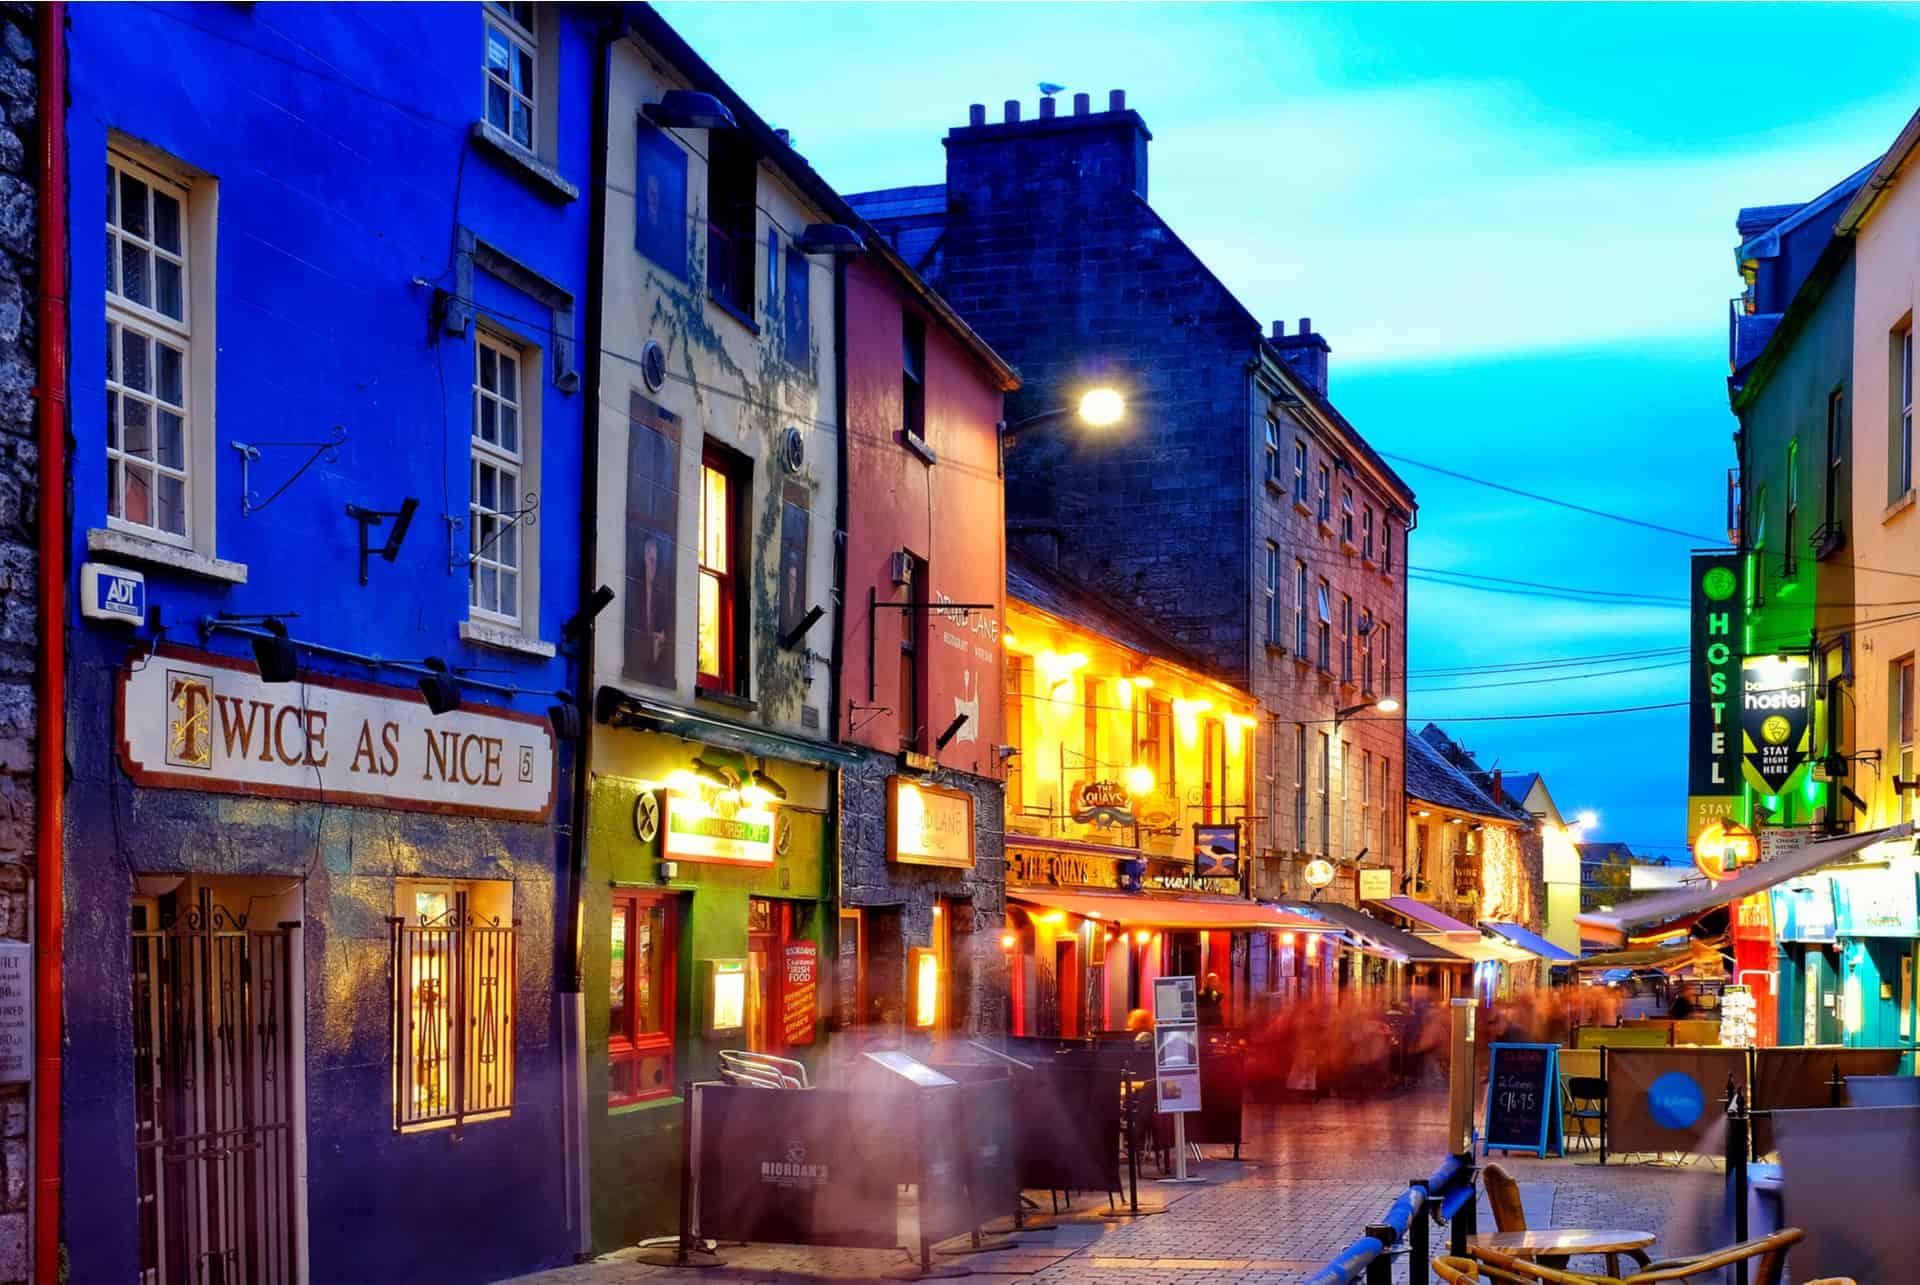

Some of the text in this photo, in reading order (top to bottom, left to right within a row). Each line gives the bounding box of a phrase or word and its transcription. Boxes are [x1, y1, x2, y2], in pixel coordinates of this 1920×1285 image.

[107, 578, 137, 604] ADT
[971, 608, 998, 644] LANE
[1707, 612, 1730, 784] HOSTEL
[1744, 690, 1806, 710] hostel
[171, 678, 504, 787] TWICE AS NICE
[1762, 746, 1789, 756] STAY
[1762, 756, 1789, 765] RIGHT
[521, 752, 532, 777] 5
[1762, 765, 1789, 775] HERE
[1086, 792, 1123, 804] QUAYS
[1097, 784, 1114, 793] THE
[1699, 804, 1732, 815] STAY
[1053, 856, 1089, 887] QUAYS
